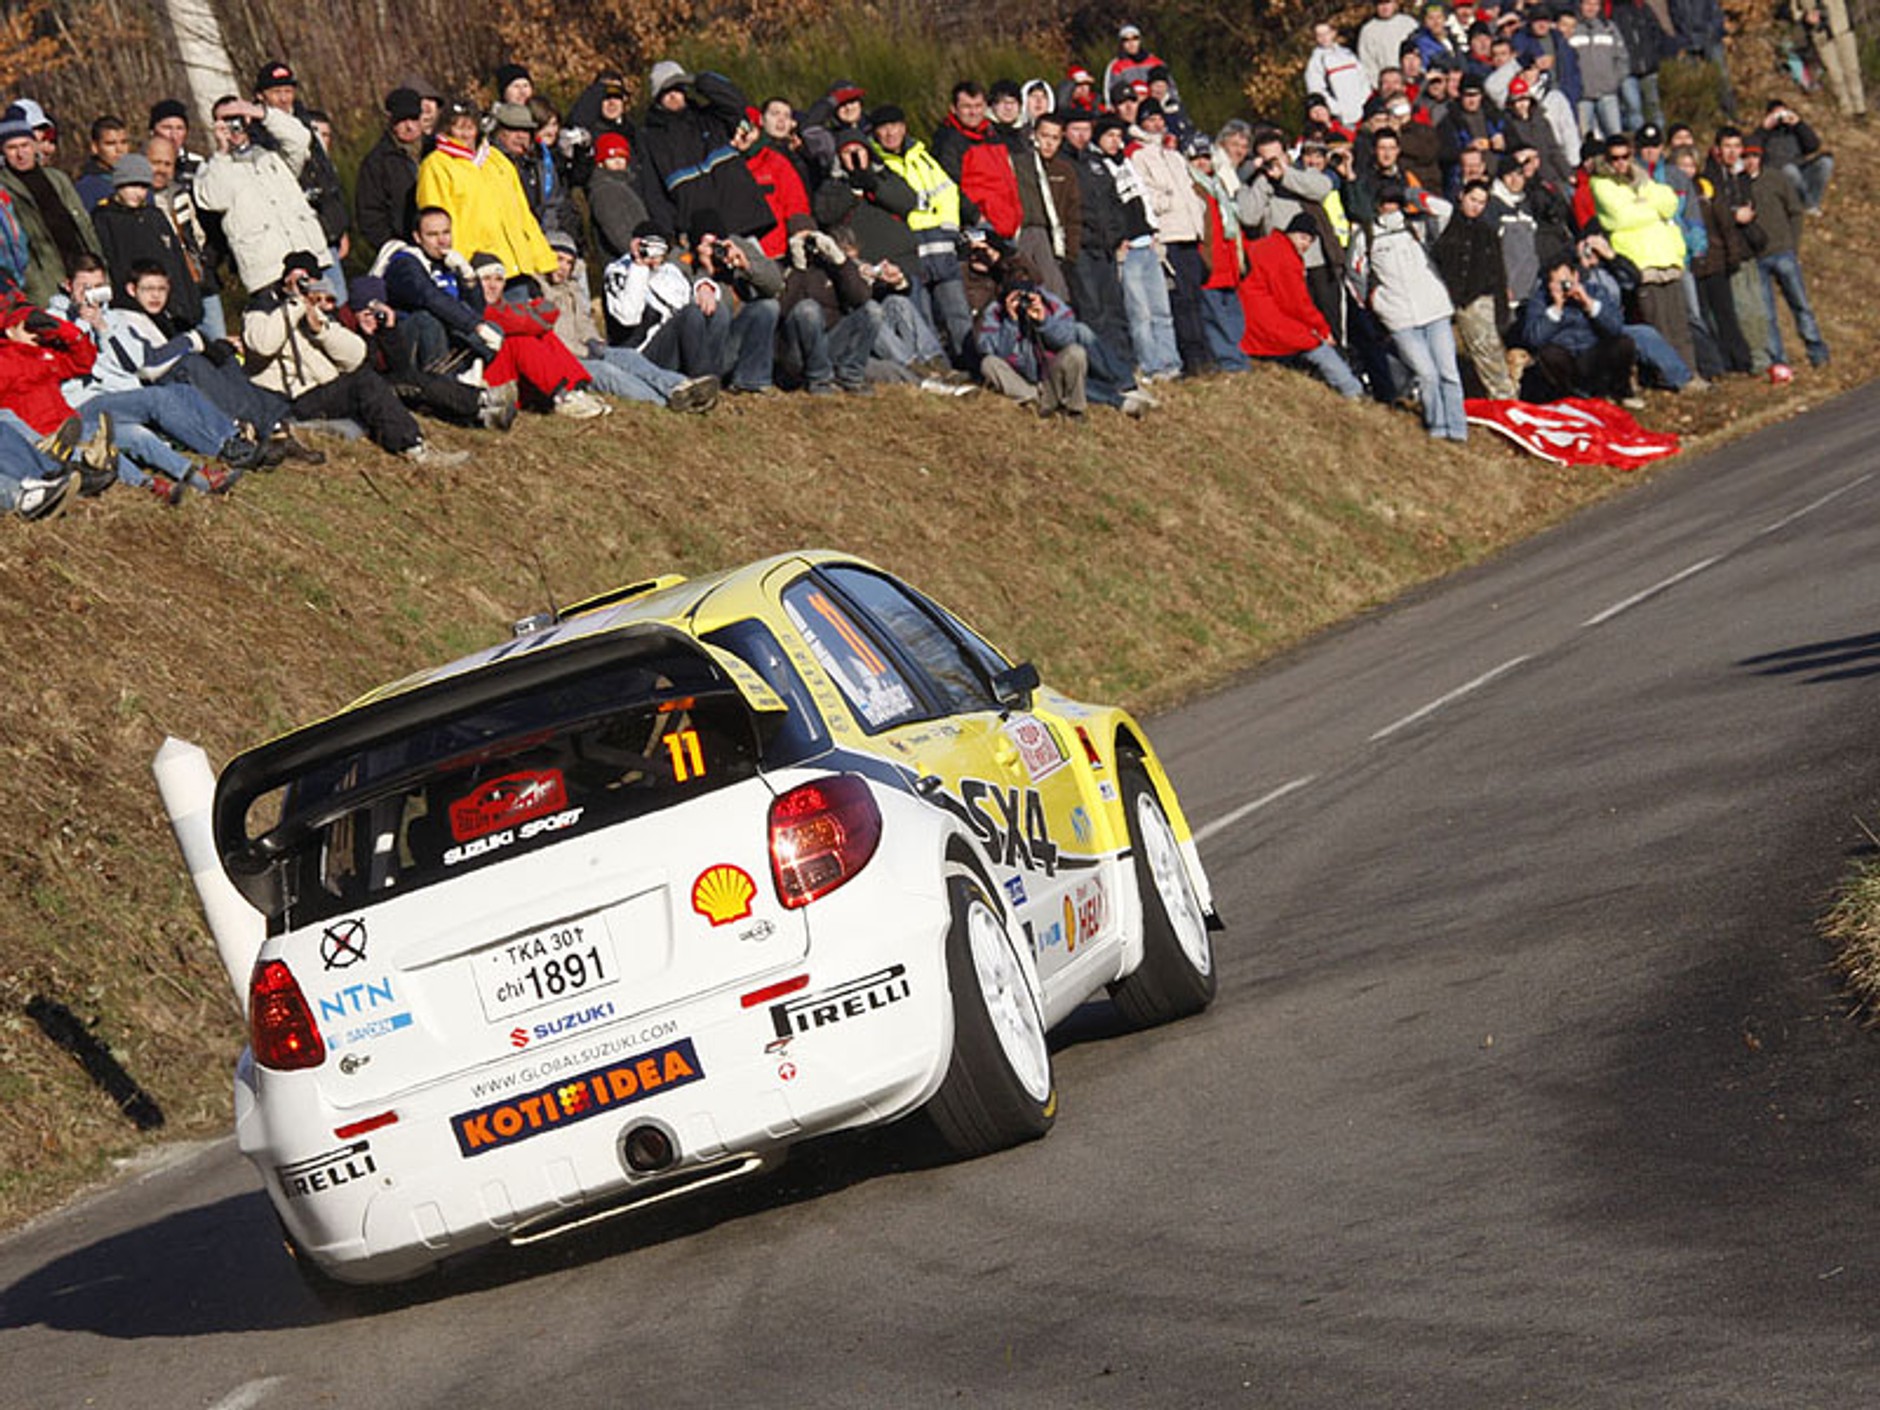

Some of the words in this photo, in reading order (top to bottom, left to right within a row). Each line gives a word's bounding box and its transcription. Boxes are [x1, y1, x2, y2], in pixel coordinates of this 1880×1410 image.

[662, 730, 706, 783] 11
[443, 829, 514, 866] SUZUKI
[518, 806, 585, 839] SPORT
[960, 779, 1057, 878] SX4
[497, 976, 526, 1003] chi
[524, 945, 605, 1000] 1891
[505, 937, 548, 966] TKA
[318, 976, 394, 1022] NTN
[533, 1001, 616, 1040] SUZUKI
[768, 963, 911, 1038] PIRELLI
[470, 1019, 679, 1100] WWW.GLOBALSUZUKI.COM
[462, 1093, 560, 1149] KOTI
[590, 1050, 695, 1105] IDEA
